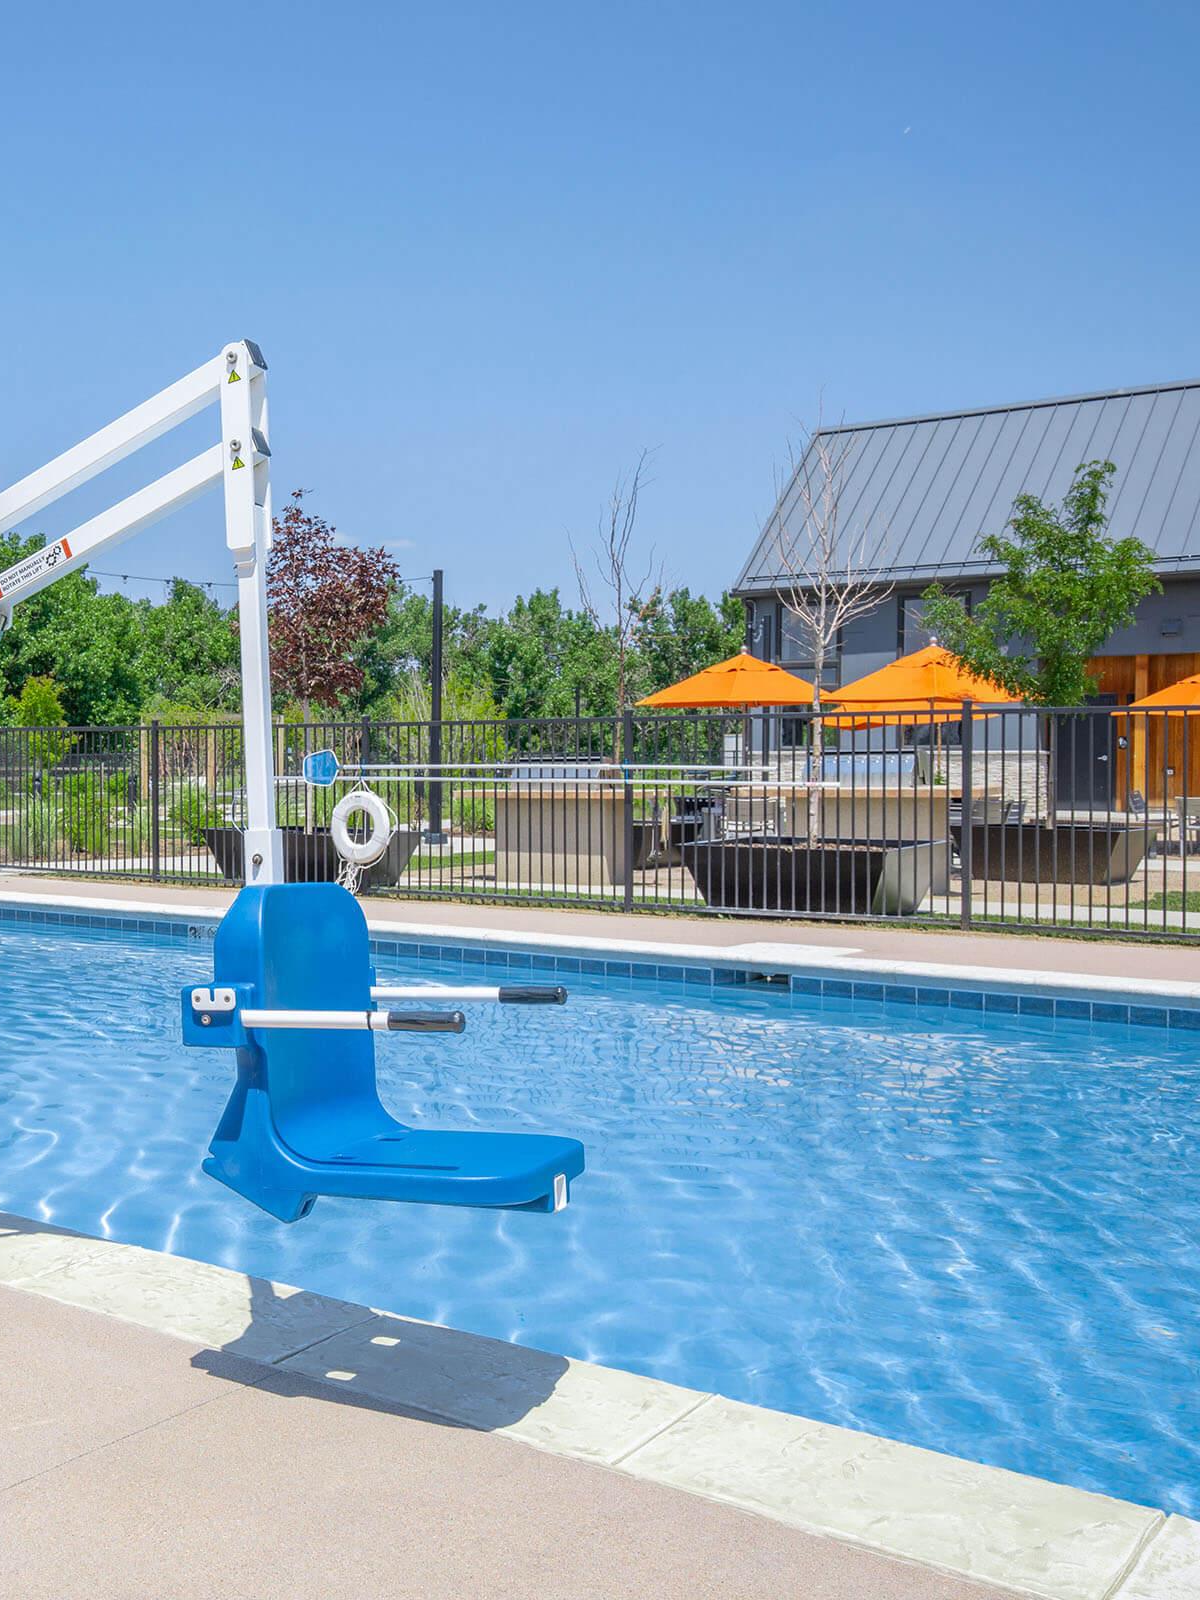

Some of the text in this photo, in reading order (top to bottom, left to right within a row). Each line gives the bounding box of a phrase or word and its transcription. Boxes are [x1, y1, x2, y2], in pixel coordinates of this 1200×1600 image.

[0, 556, 46, 586] DO NOT MANUALLY
[3, 565, 43, 592] ROTATE THIS LIFT
